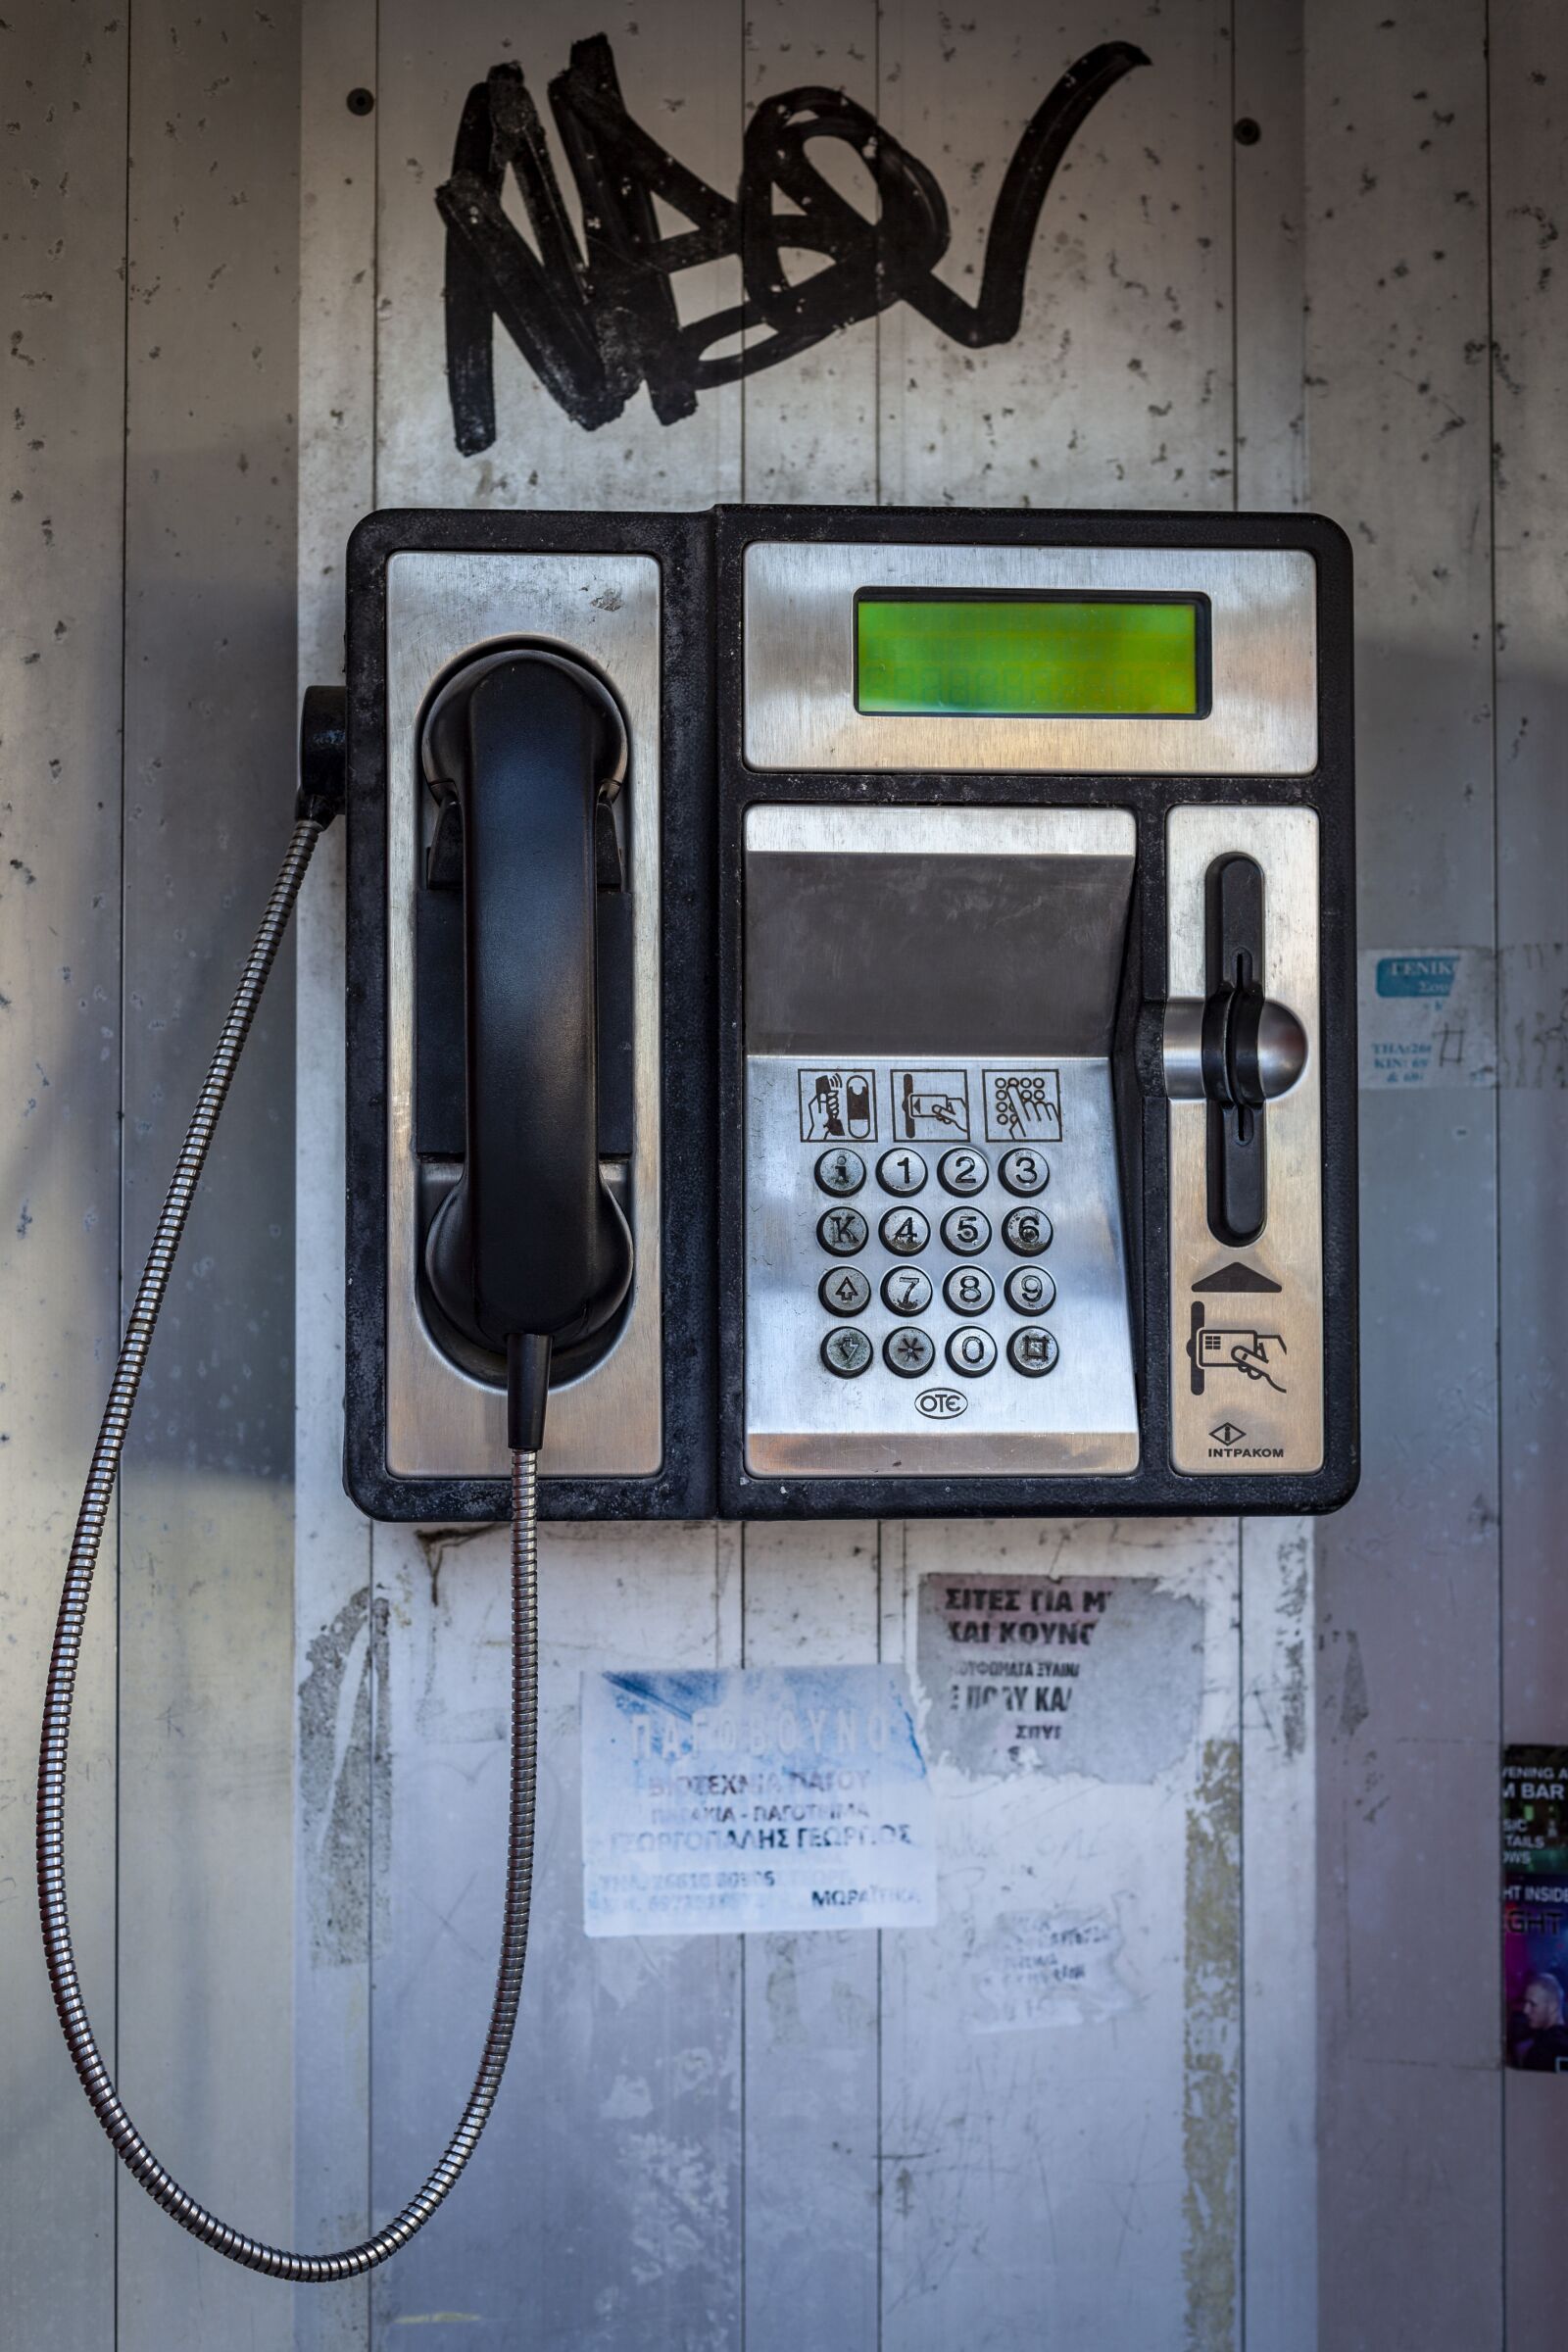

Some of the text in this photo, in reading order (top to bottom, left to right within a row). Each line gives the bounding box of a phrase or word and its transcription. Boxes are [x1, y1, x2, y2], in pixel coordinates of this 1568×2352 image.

[896, 1155, 910, 1184] 1
[955, 1155, 976, 1184] 2
[1015, 1155, 1037, 1185] 3
[896, 1215, 917, 1244] 4
[956, 1215, 978, 1244] 5
[1018, 1215, 1040, 1245] 6
[899, 1275, 1044, 1304] 7 8 9
[961, 1336, 984, 1363] 0
[945, 1588, 1113, 1614] ΣΙΤΕΣ ΓΙΑ Μ
[953, 1659, 1034, 1677] ΟΥΦΩΜΑΤΑ
[1520, 1783, 1565, 1800] BAR
